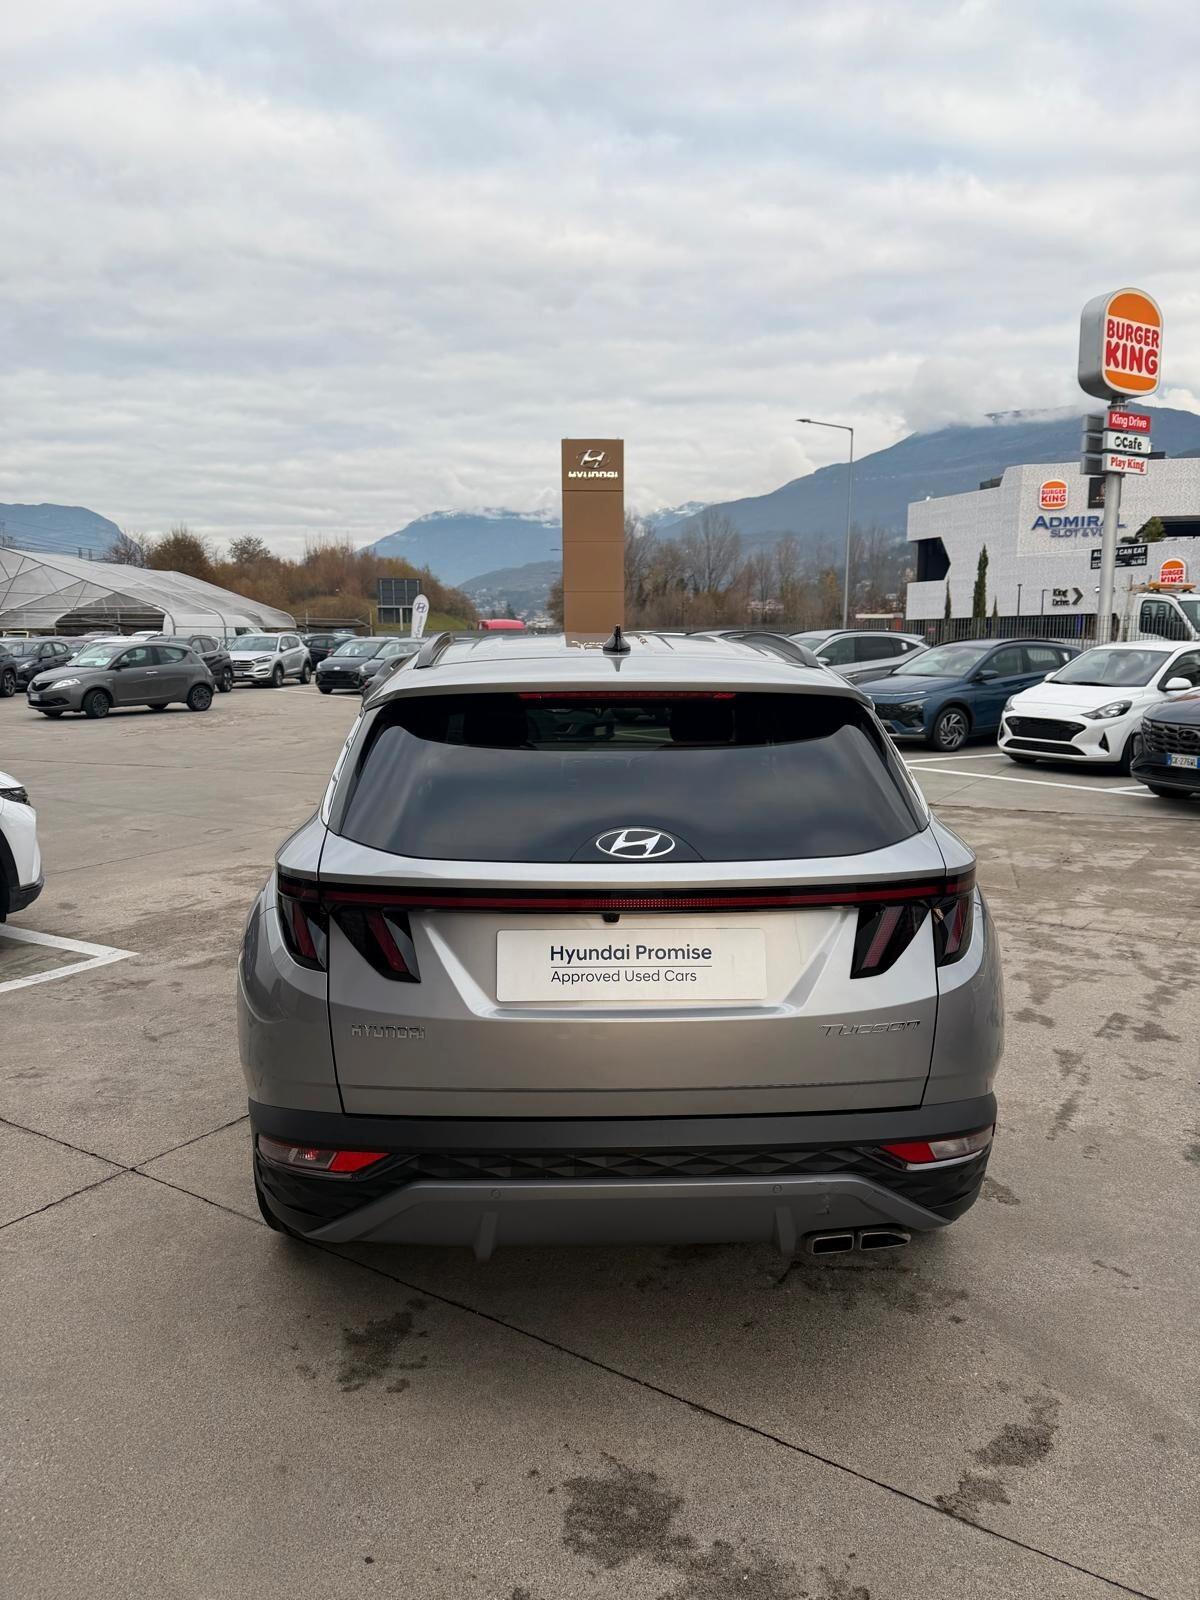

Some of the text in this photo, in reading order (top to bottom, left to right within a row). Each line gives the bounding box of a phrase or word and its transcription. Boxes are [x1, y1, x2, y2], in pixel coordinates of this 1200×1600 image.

[1107, 318, 1159, 348] BURGER
[1105, 339, 1158, 375] KING
[1111, 413, 1147, 428] King Drive
[1122, 436, 1142, 450] Cafe
[1110, 456, 1145, 473] Play King
[567, 470, 619, 479] HYUNDAI
[1041, 494, 1066, 502] KING
[1031, 515, 1127, 530] ADMIRL
[1050, 528, 1079, 538] SLOT
[550, 944, 712, 964] Hyundai Promise
[550, 970, 697, 985] Approved Used Cars
[351, 1024, 425, 1039] HYUNDAI
